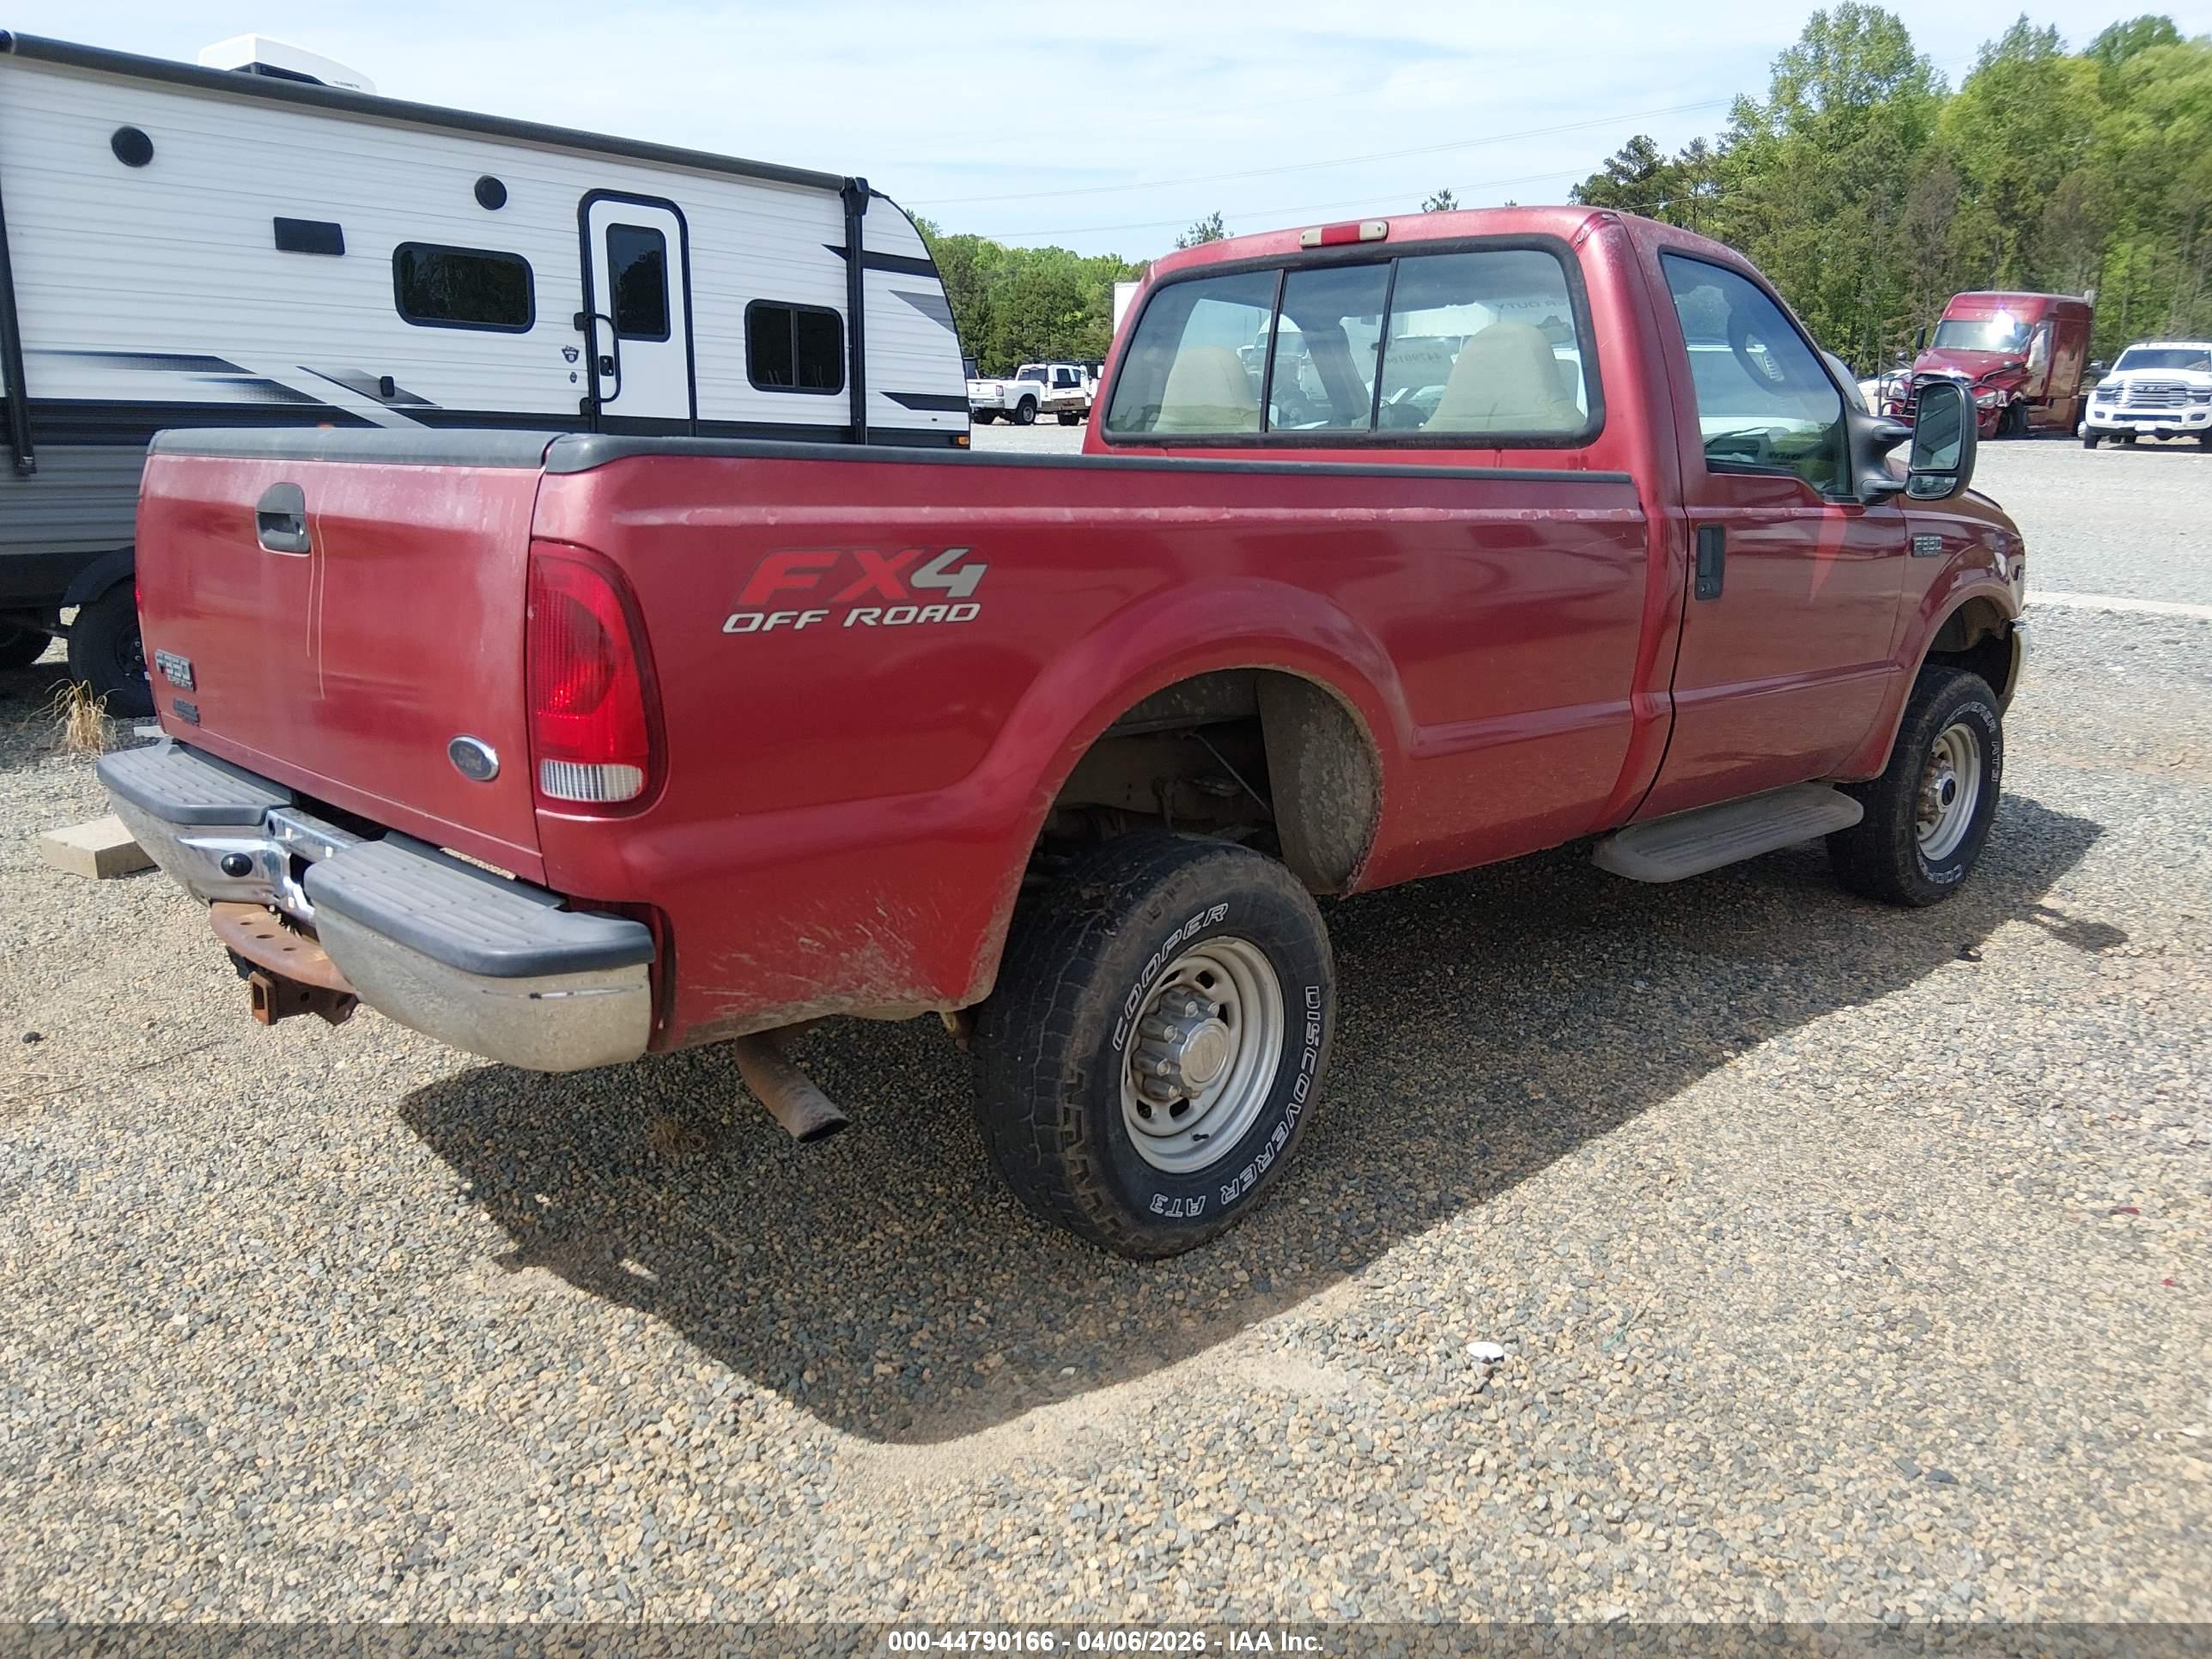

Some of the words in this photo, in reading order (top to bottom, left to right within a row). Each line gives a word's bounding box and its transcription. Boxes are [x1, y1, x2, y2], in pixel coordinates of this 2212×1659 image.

[735, 548, 988, 605] FX4
[722, 609, 830, 634] OFF
[842, 603, 981, 628] ROAD
[1112, 902, 1229, 1052] COOPER
[1220, 985, 1322, 1206] DISCOVERER
[1149, 1193, 1207, 1218] AT3
